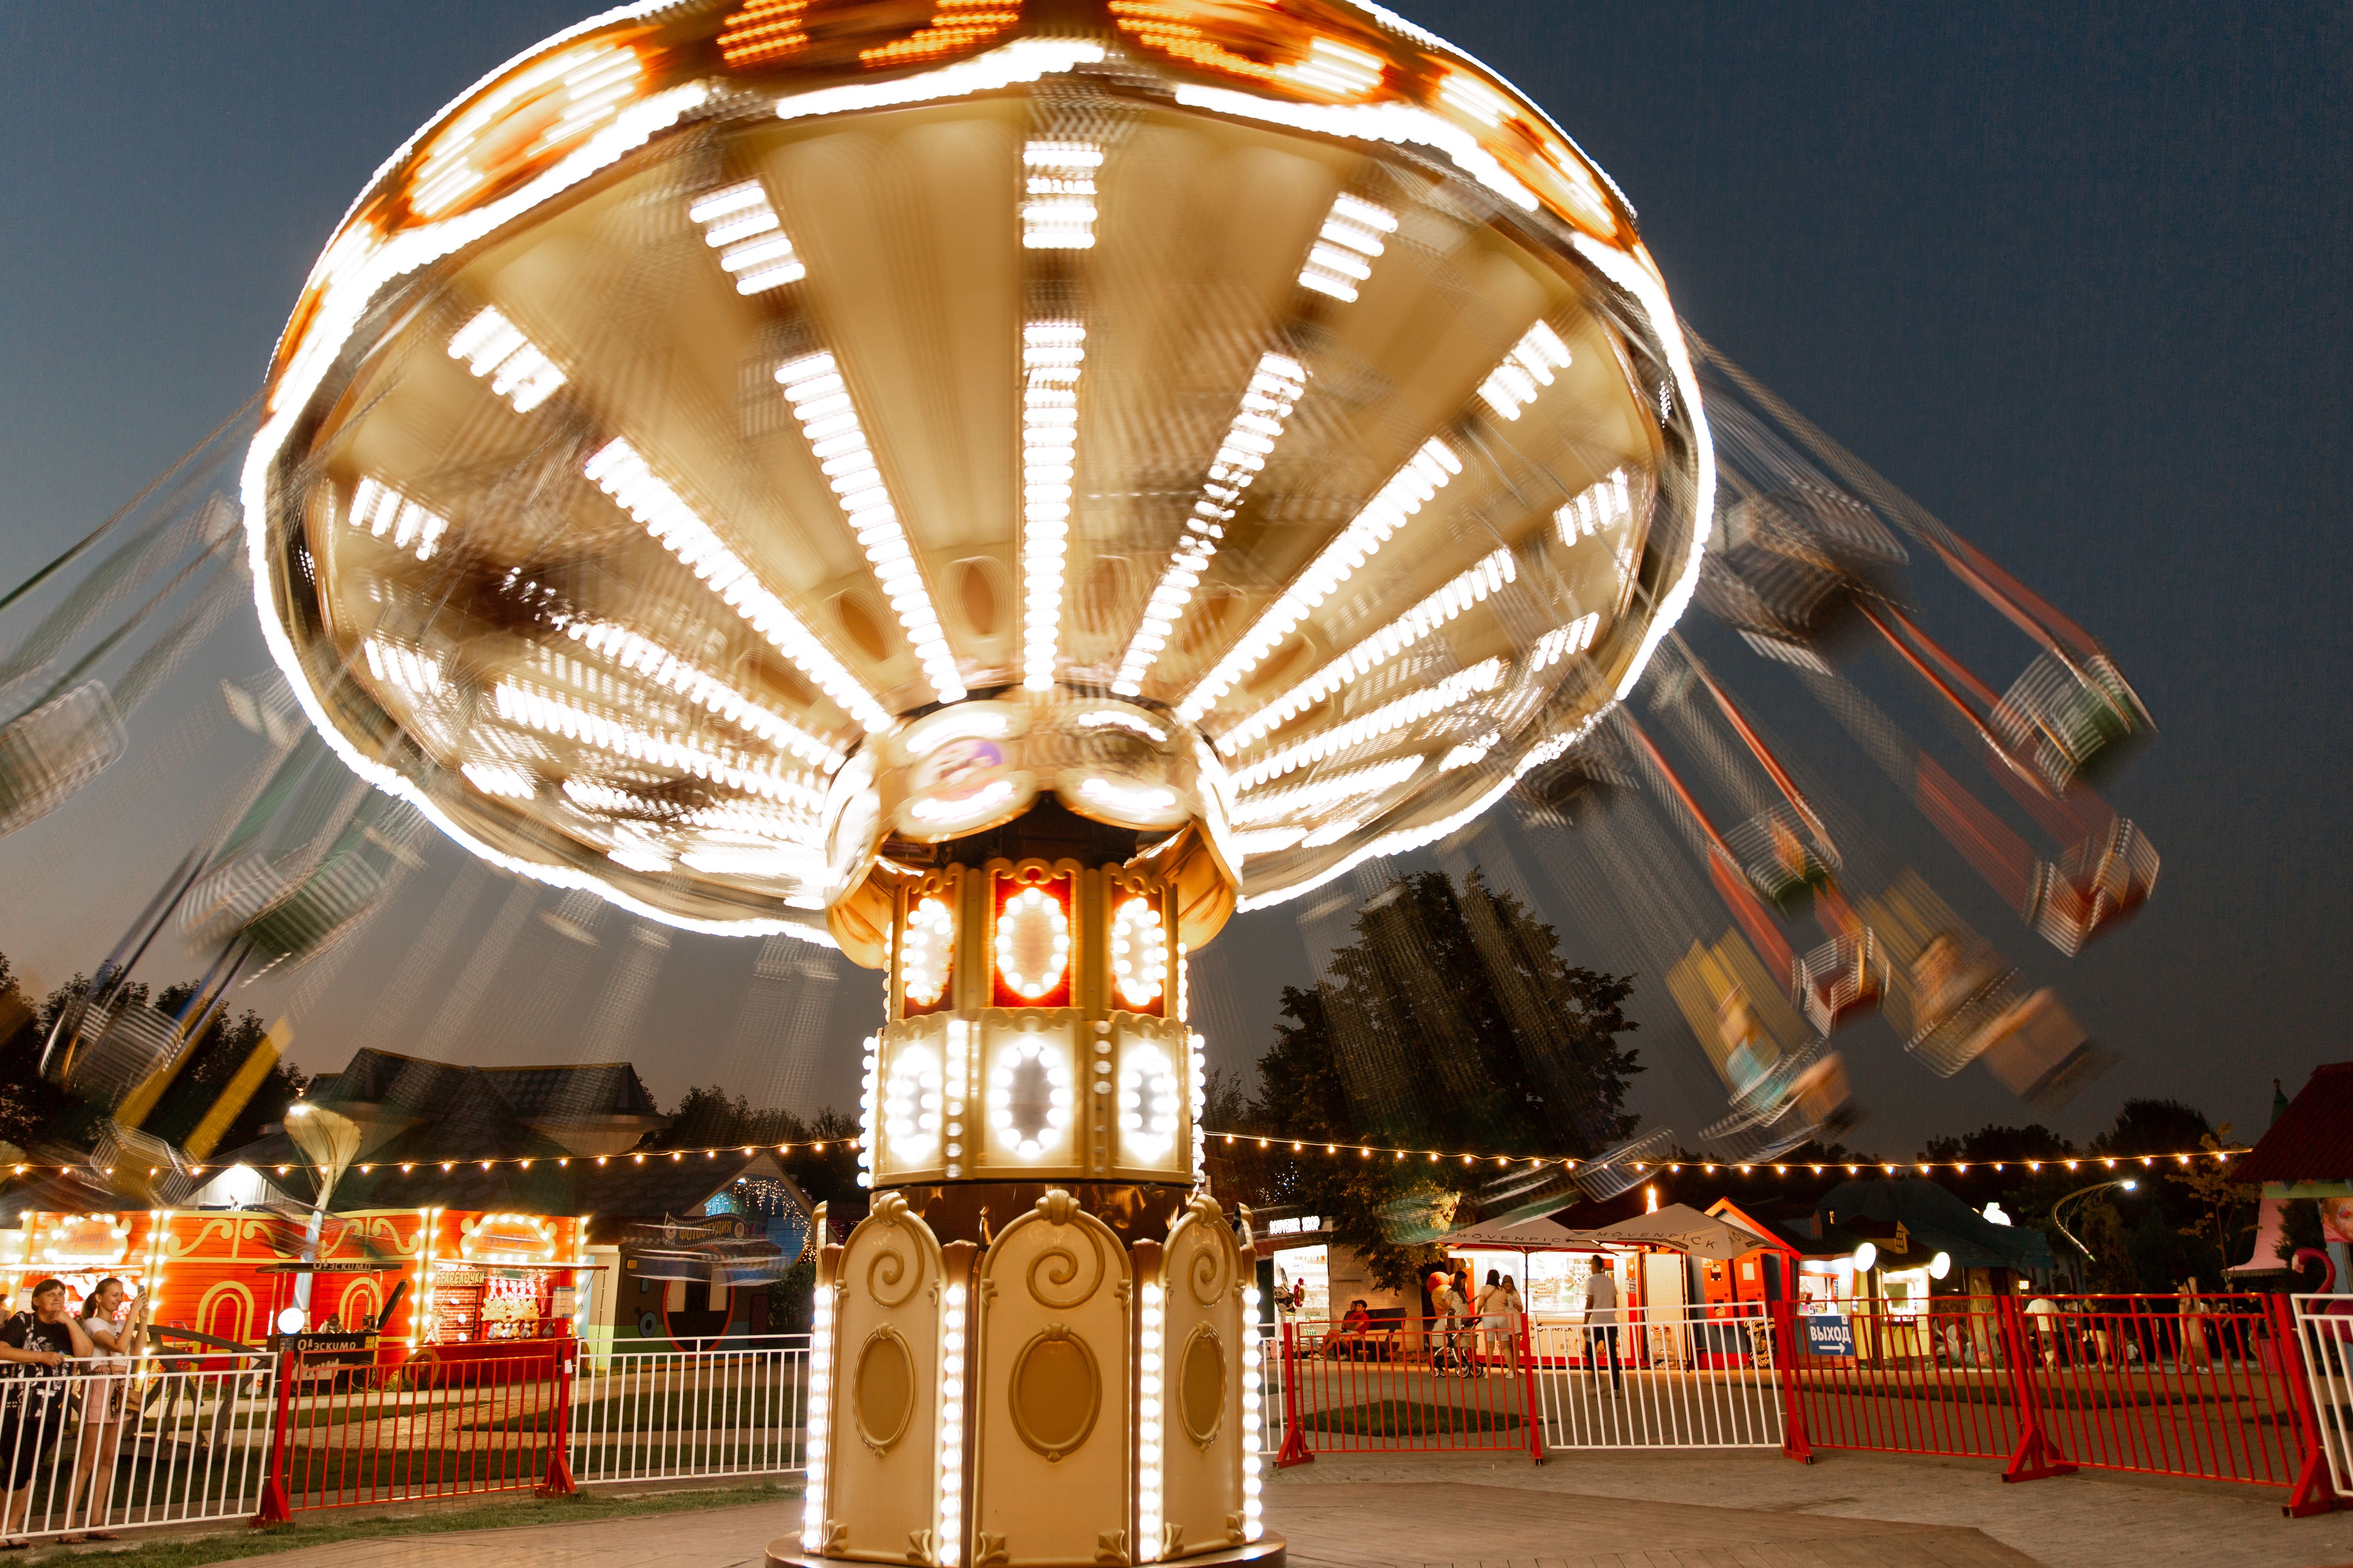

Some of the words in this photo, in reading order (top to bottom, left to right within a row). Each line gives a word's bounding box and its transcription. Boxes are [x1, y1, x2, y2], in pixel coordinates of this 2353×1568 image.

[1269, 1218, 1301, 1235] SOUVENIR
[1301, 1215, 1320, 1232] SHOP
[440, 1271, 485, 1285] ТАРЕЛОЧКИ
[1810, 1326, 1852, 1343] ВЫХОД
